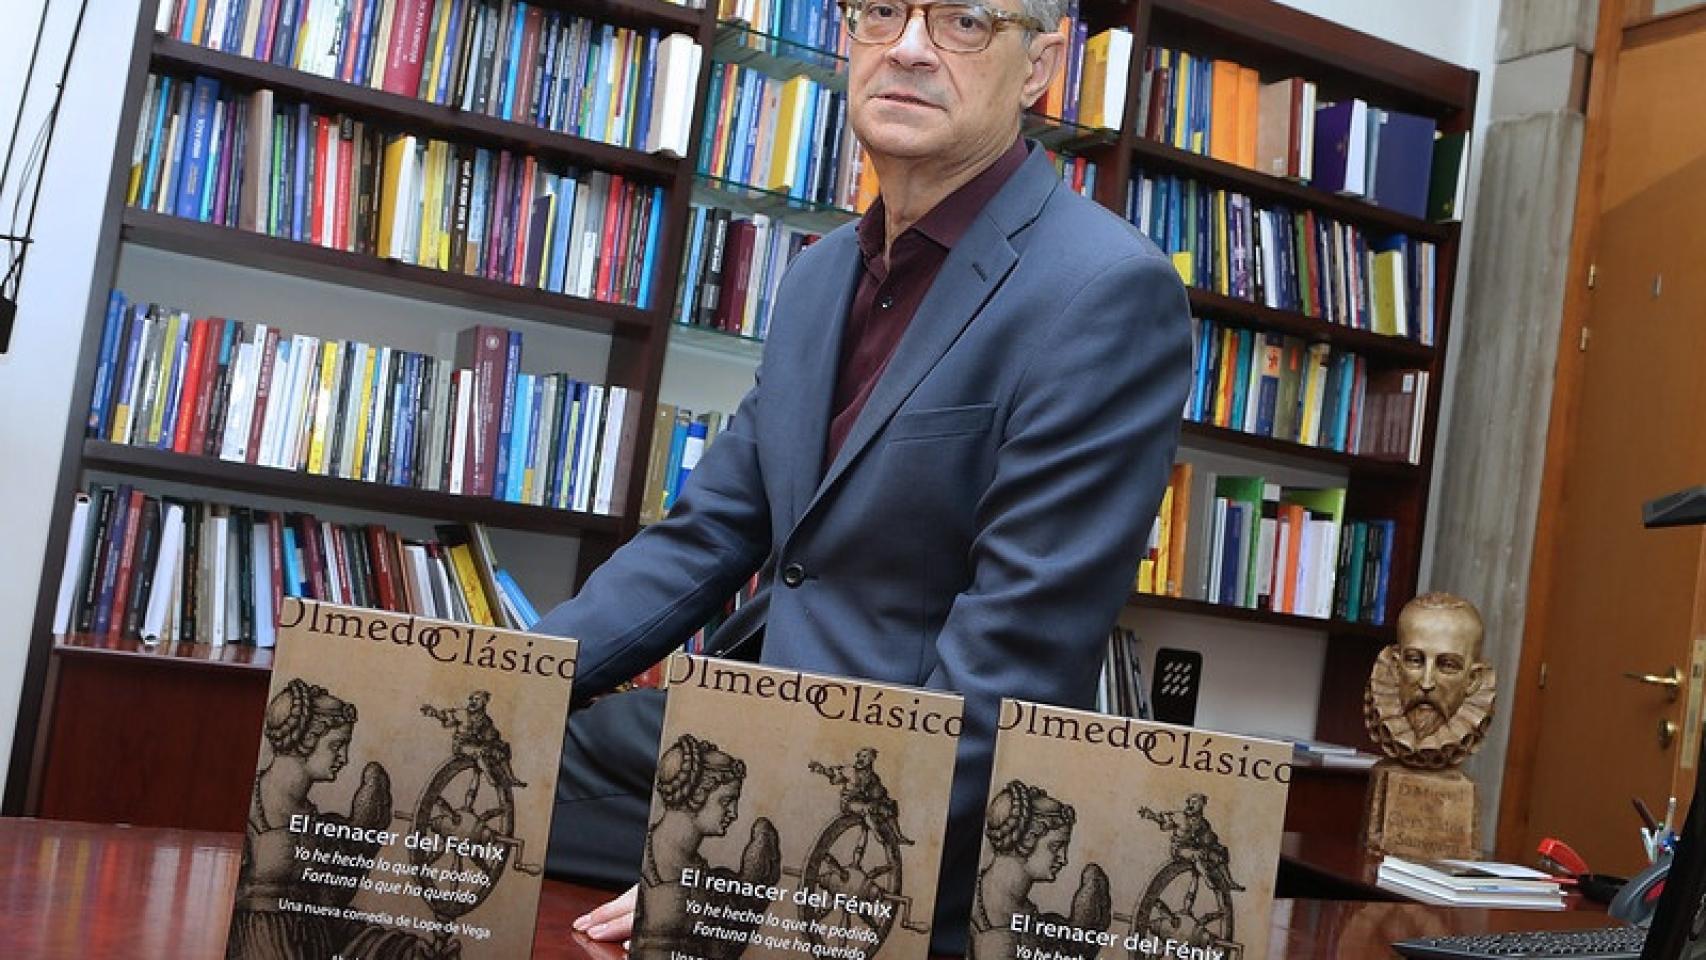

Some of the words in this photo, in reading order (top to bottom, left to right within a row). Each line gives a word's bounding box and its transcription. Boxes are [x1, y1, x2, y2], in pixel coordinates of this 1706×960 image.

[289, 814, 310, 833] El
[315, 821, 399, 846] renacer
[404, 831, 440, 852] del
[445, 836, 504, 860] Fénix
[294, 846, 310, 861] Yo
[312, 848, 331, 864] he
[332, 850, 374, 869] hecho
[377, 857, 391, 872] lo
[392, 862, 419, 877] que
[420, 863, 439, 880] he
[439, 868, 491, 889] podido,
[302, 867, 357, 888] Fortuna
[359, 875, 374, 890] lo
[374, 880, 402, 895] que
[403, 881, 422, 897] ha
[424, 887, 478, 905] querido
[681, 867, 700, 889] El
[705, 876, 788, 901] renacer
[793, 887, 829, 909] del
[834, 893, 892, 918] Fénix
[279, 898, 302, 912] Una
[304, 904, 340, 918] nueva
[342, 909, 393, 926] comedia
[396, 914, 411, 928] de
[413, 917, 442, 933] Lope
[443, 921, 460, 934] de
[462, 924, 491, 940] Vega
[686, 899, 702, 914] Yo
[704, 902, 722, 918] he
[722, 904, 765, 925] hecho
[766, 912, 780, 928] lo
[781, 918, 808, 933] que
[809, 919, 828, 936] he
[827, 925, 879, 946] podido,
[693, 921, 748, 942] Fortuna
[748, 929, 762, 945] lo
[764, 935, 791, 950] que
[792, 937, 811, 953] ha
[812, 943, 867, 960] querido
[1010, 913, 1031, 933] El
[1035, 921, 1119, 947] renacer
[1123, 932, 1159, 954] del
[1165, 938, 1224, 960] Fénix
[1016, 944, 1032, 959] Yo
